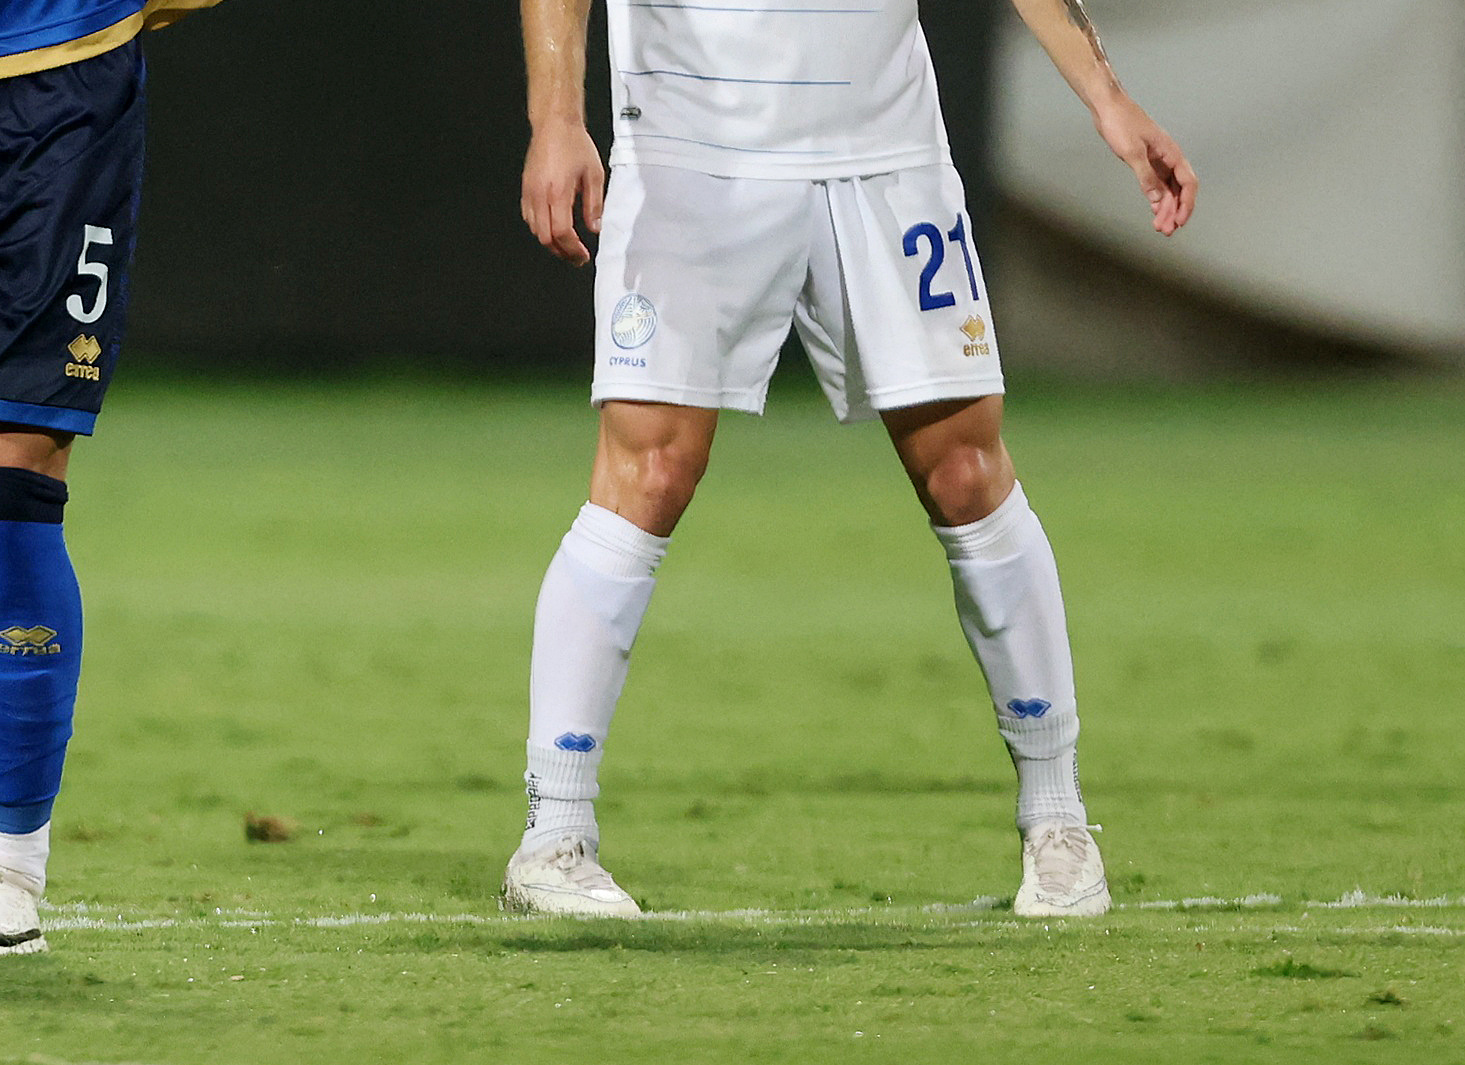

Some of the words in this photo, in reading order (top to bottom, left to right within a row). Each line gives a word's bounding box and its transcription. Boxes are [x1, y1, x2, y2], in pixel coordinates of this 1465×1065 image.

[65, 224, 114, 324] 5
[902, 212, 980, 312] 21
[609, 356, 647, 368] CYPRUS
